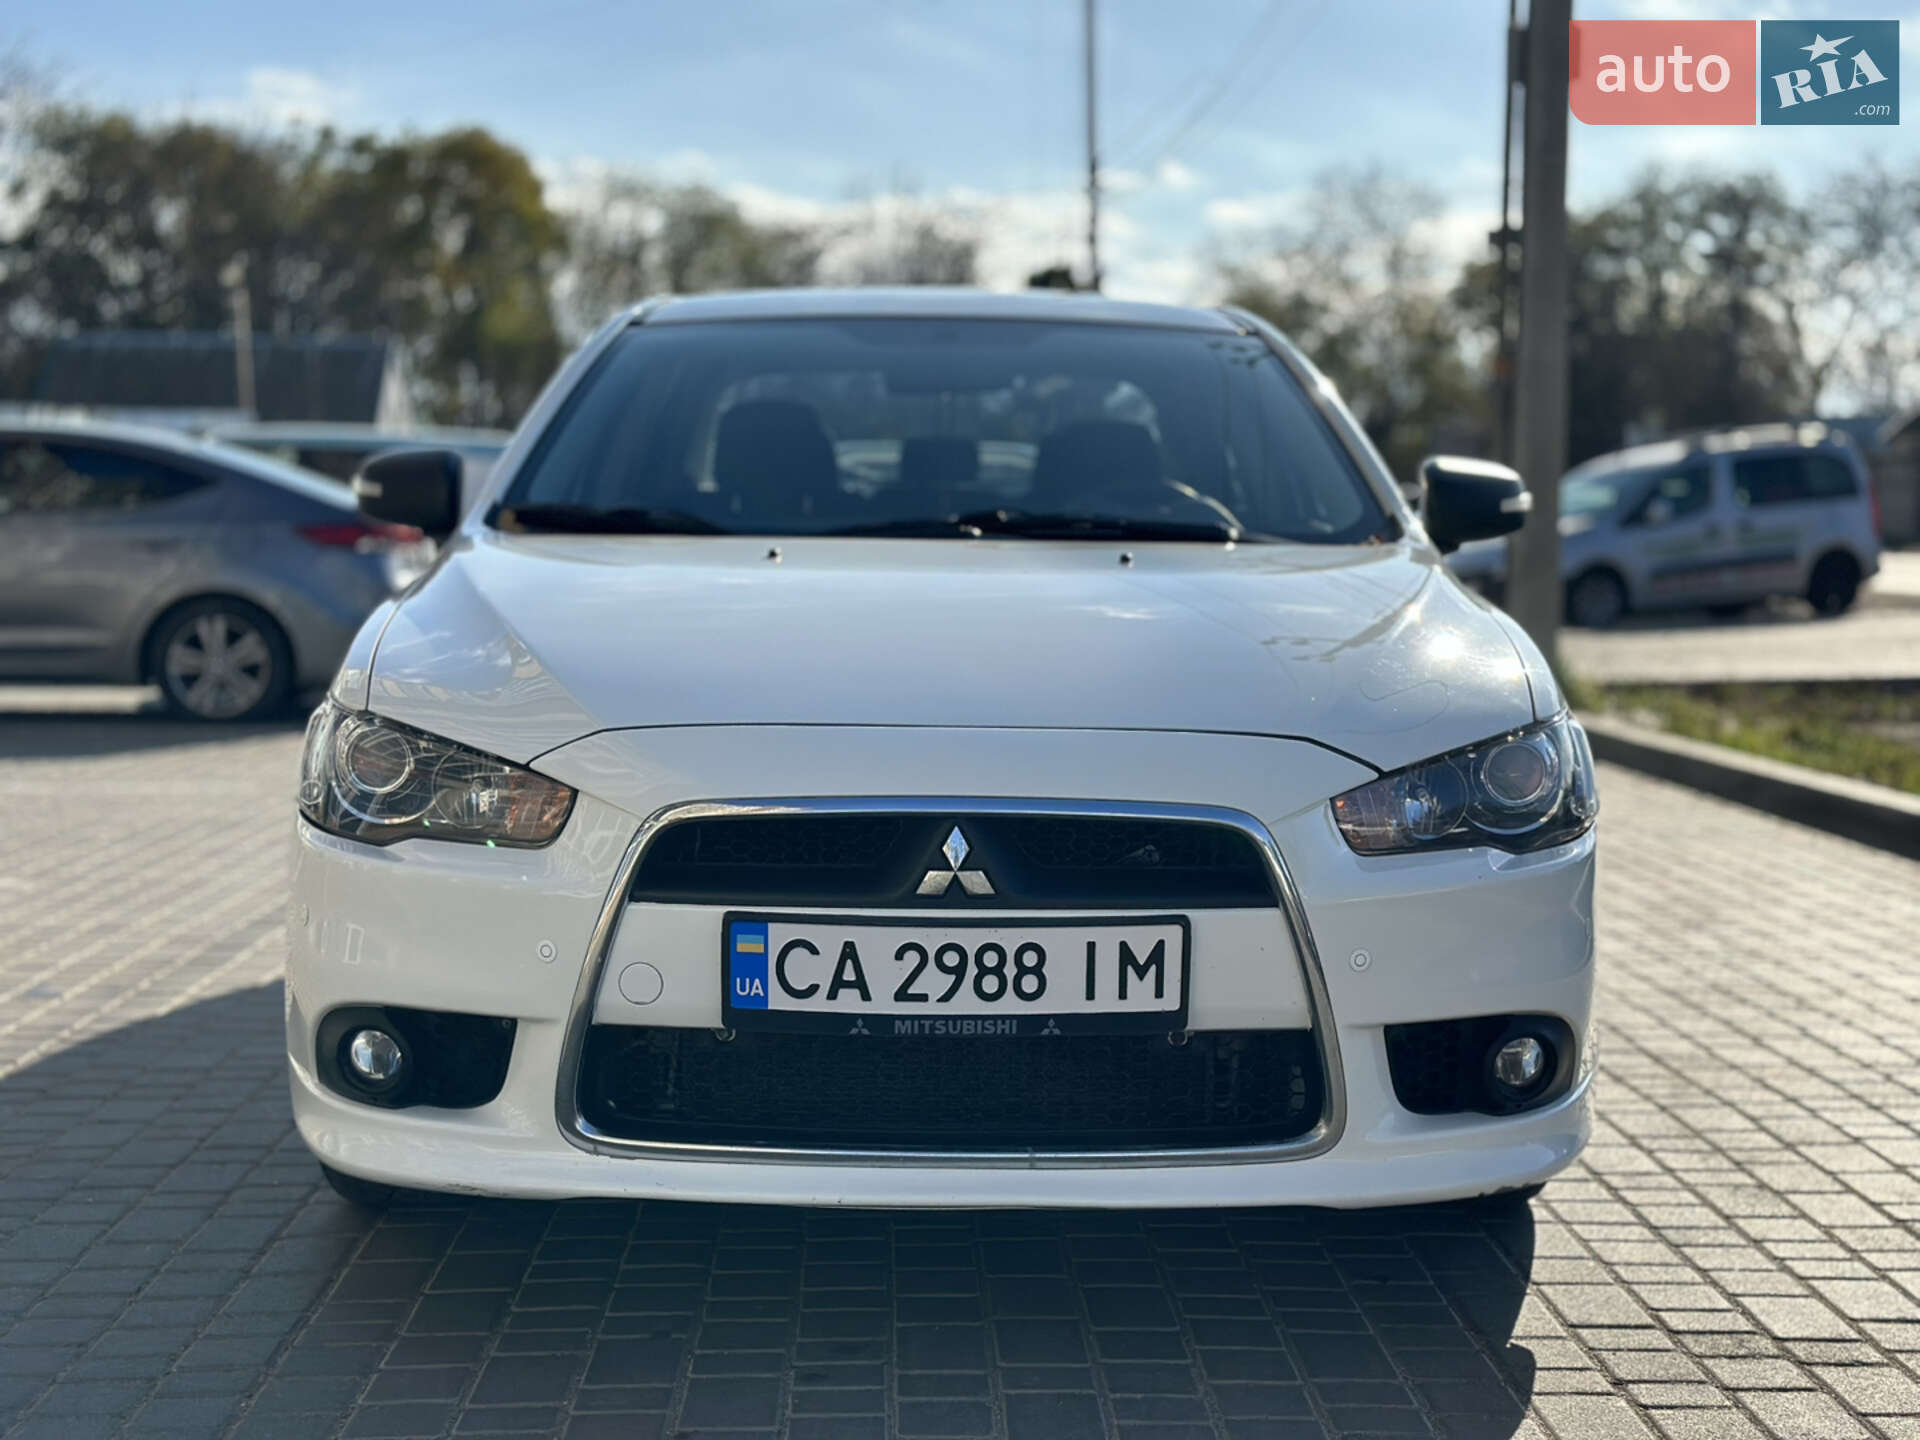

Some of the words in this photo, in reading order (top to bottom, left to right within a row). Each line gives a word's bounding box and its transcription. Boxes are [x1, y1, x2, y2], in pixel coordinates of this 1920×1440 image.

[775, 938, 873, 1002] CA
[893, 942, 1048, 1003] 2988
[1085, 938, 1166, 1001] IM
[735, 977, 765, 997] UA
[893, 1018, 1018, 1035] MITSUBISHI
